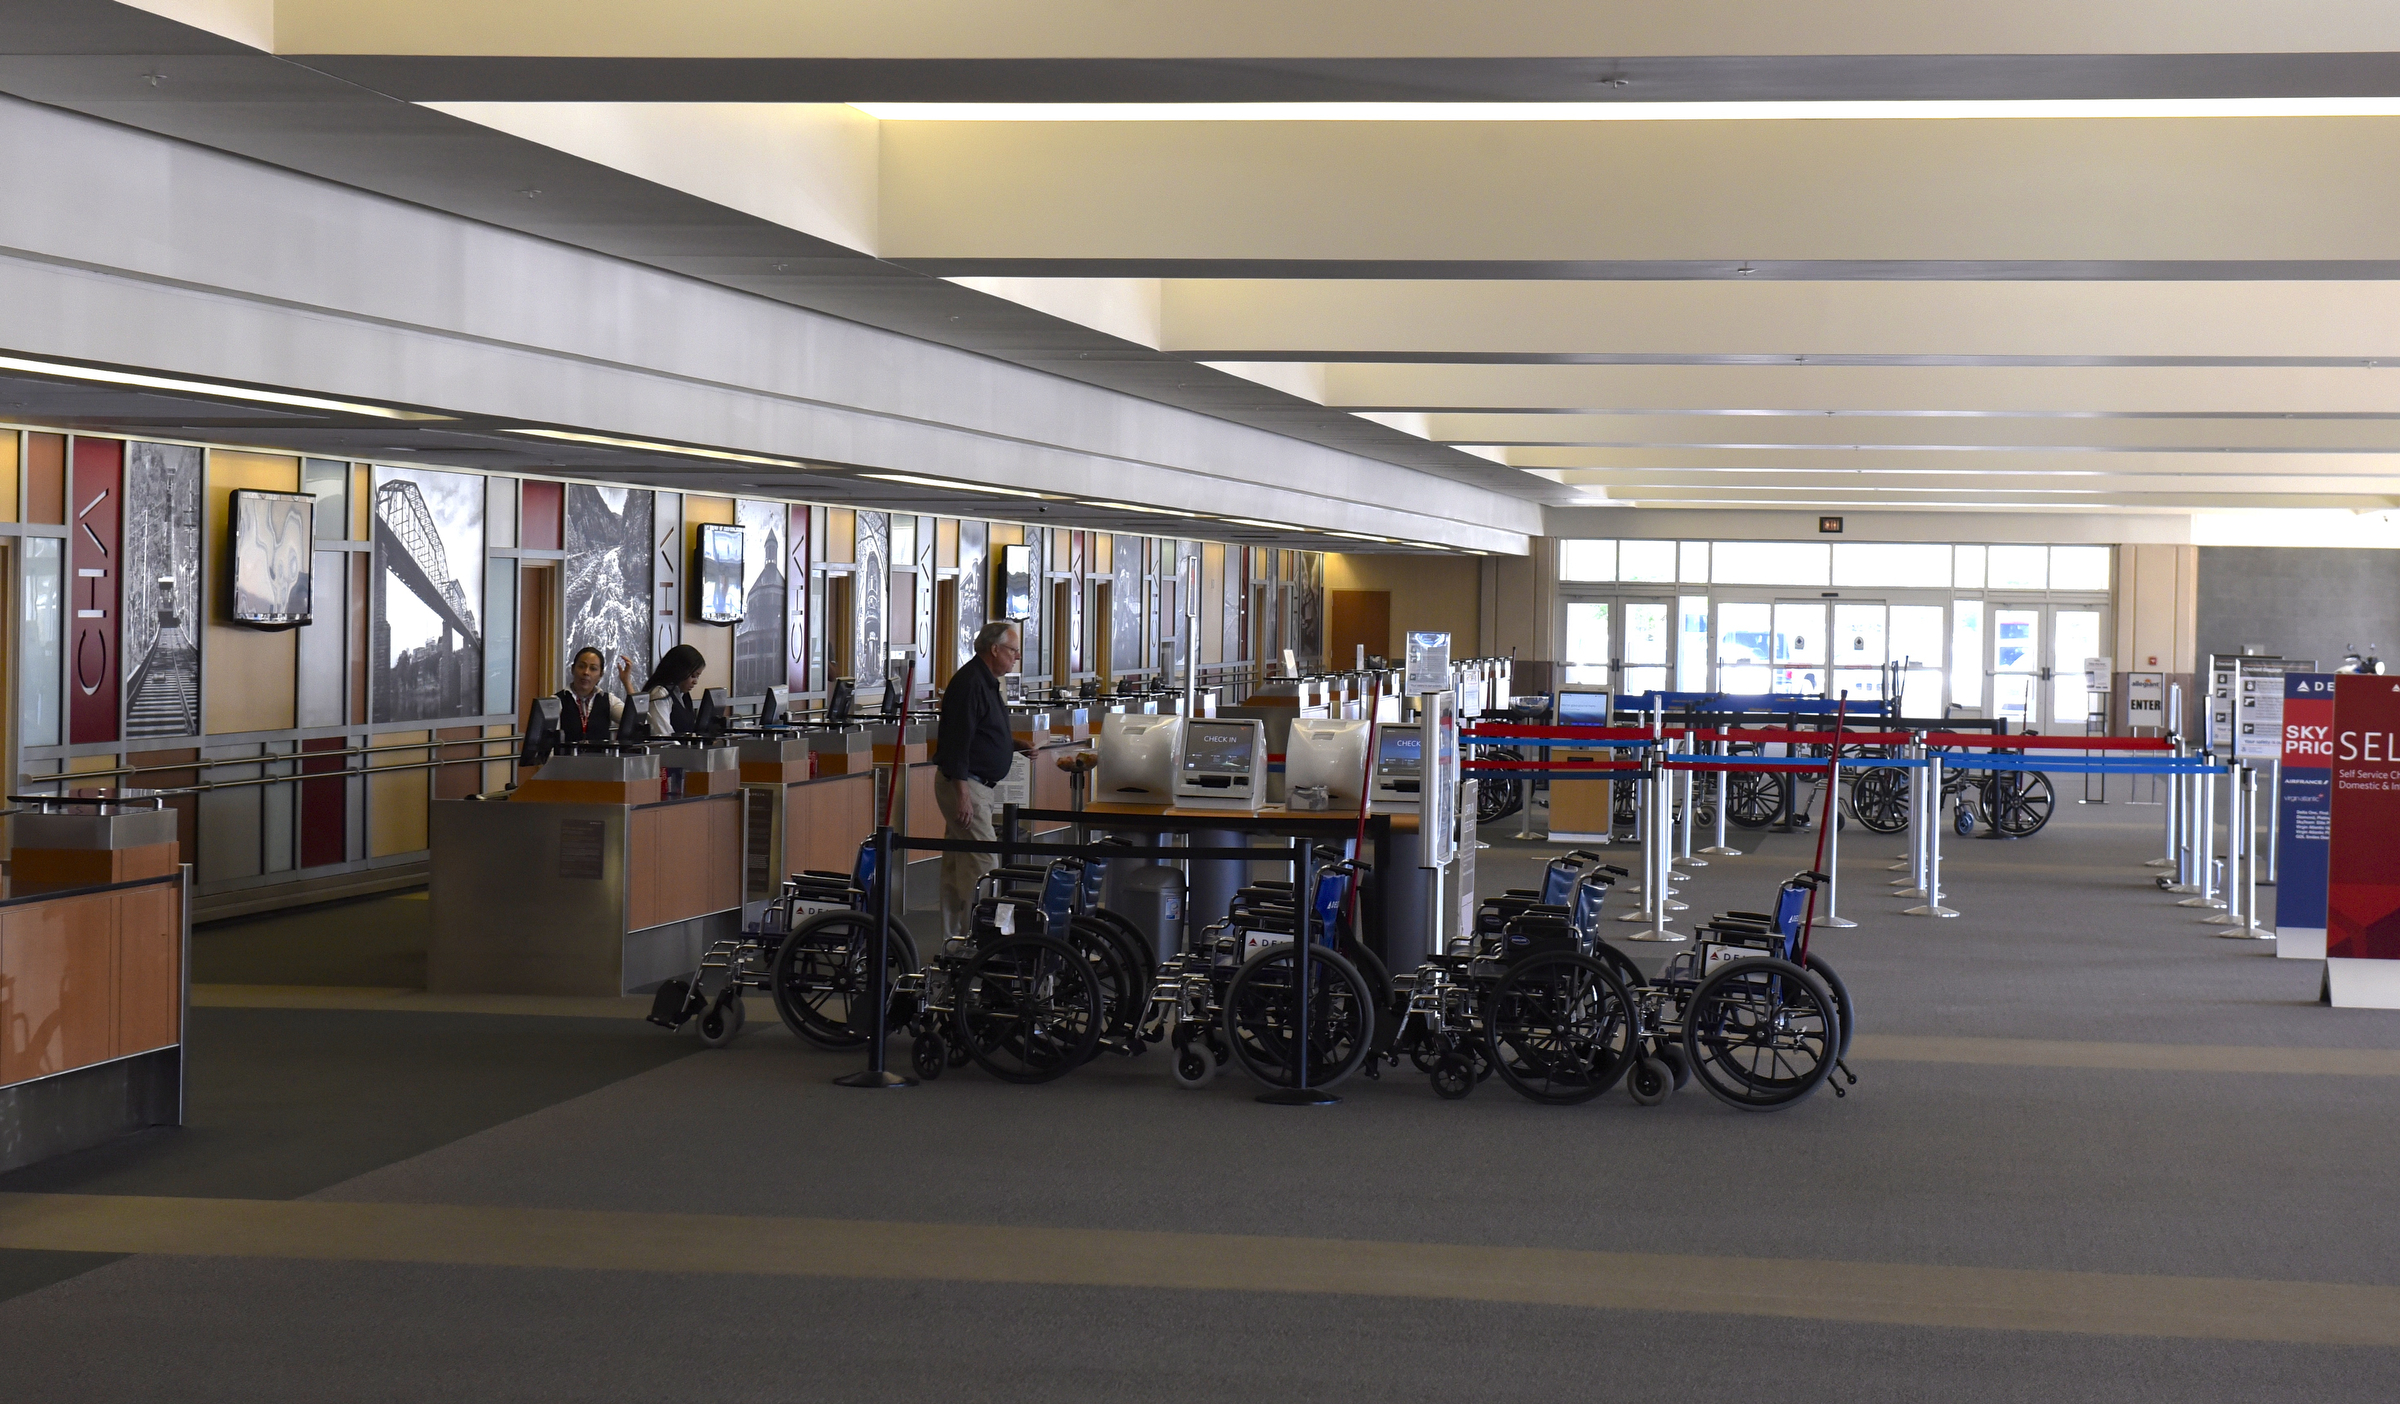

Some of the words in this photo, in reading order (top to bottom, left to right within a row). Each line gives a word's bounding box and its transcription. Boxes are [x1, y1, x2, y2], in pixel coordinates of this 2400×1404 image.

[2132, 680, 2160, 688] allegiant
[2130, 700, 2161, 711] ENTER
[2285, 725, 2329, 740] SKY
[1203, 735, 1229, 743] CHECK
[1396, 739, 1421, 748] CHECK
[2339, 731, 2400, 762] SEL
[2339, 769, 2356, 779] Self
[2357, 770, 2389, 780] Service
[2338, 780, 2380, 790] Domestic
[2381, 781, 2390, 791] &
